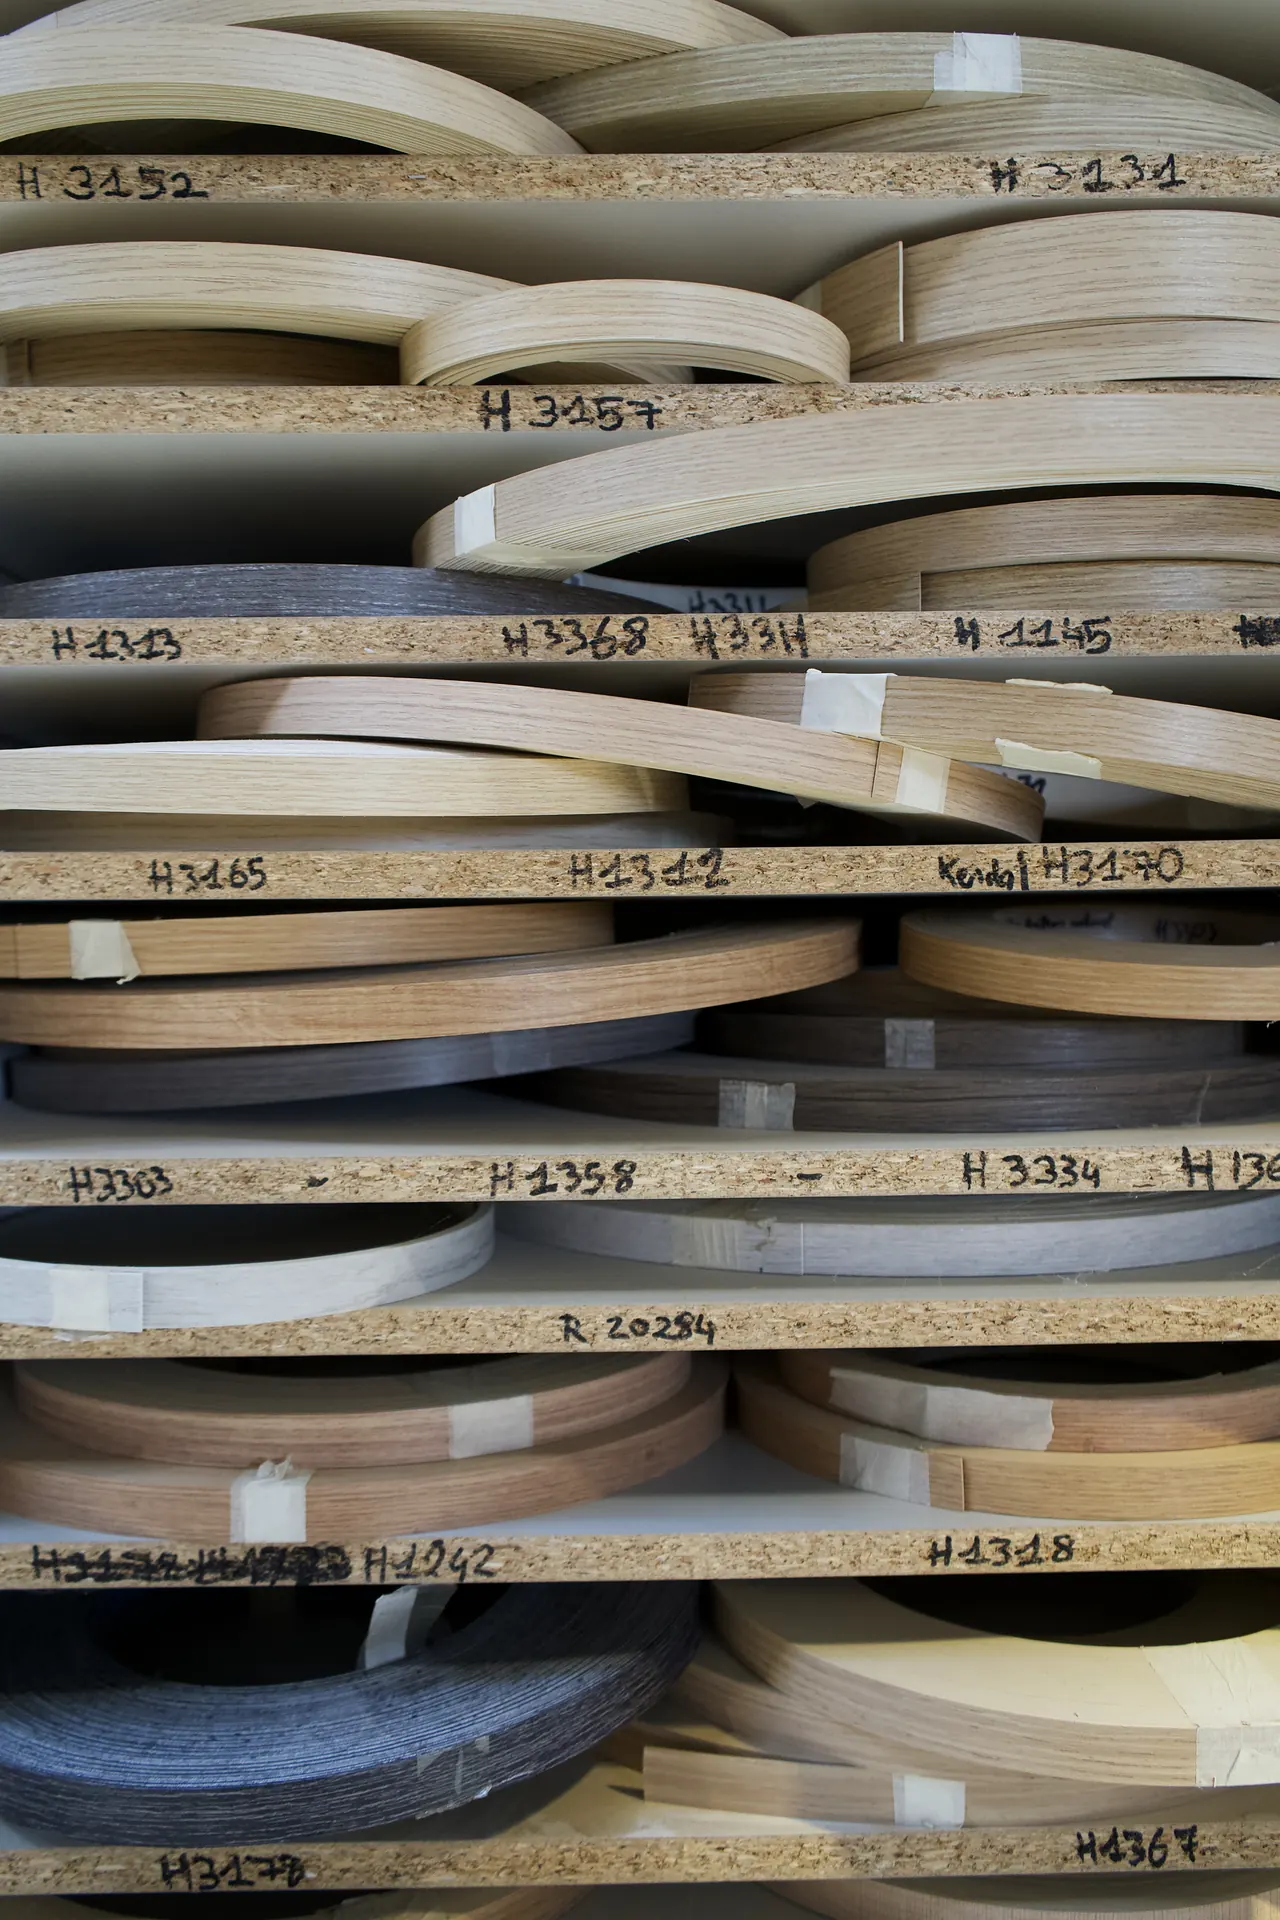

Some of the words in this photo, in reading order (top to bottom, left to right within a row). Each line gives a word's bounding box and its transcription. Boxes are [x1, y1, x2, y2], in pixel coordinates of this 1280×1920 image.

[16, 162, 41, 199] H
[63, 165, 208, 199] 3152
[990, 157, 1018, 193] H
[1036, 153, 1187, 193] 3131
[479, 389, 512, 432] H
[527, 393, 663, 431] 3157
[52, 626, 182, 660] H1313
[502, 616, 648, 660] H3368
[954, 616, 981, 651] H
[997, 615, 1112, 654] 1145
[149, 856, 267, 894] H3165
[568, 848, 730, 889] H1312
[1042, 846, 1184, 887] H3170
[67, 1166, 174, 1203] H3363
[490, 1161, 515, 1197] H
[525, 1159, 638, 1197] 1358
[962, 1150, 987, 1190] H
[1001, 1154, 1100, 1189] 3334
[1181, 1146, 1214, 1191] H
[559, 1313, 589, 1344] R
[927, 1533, 1077, 1567] H1318
[1075, 1824, 1198, 1868] H1367
